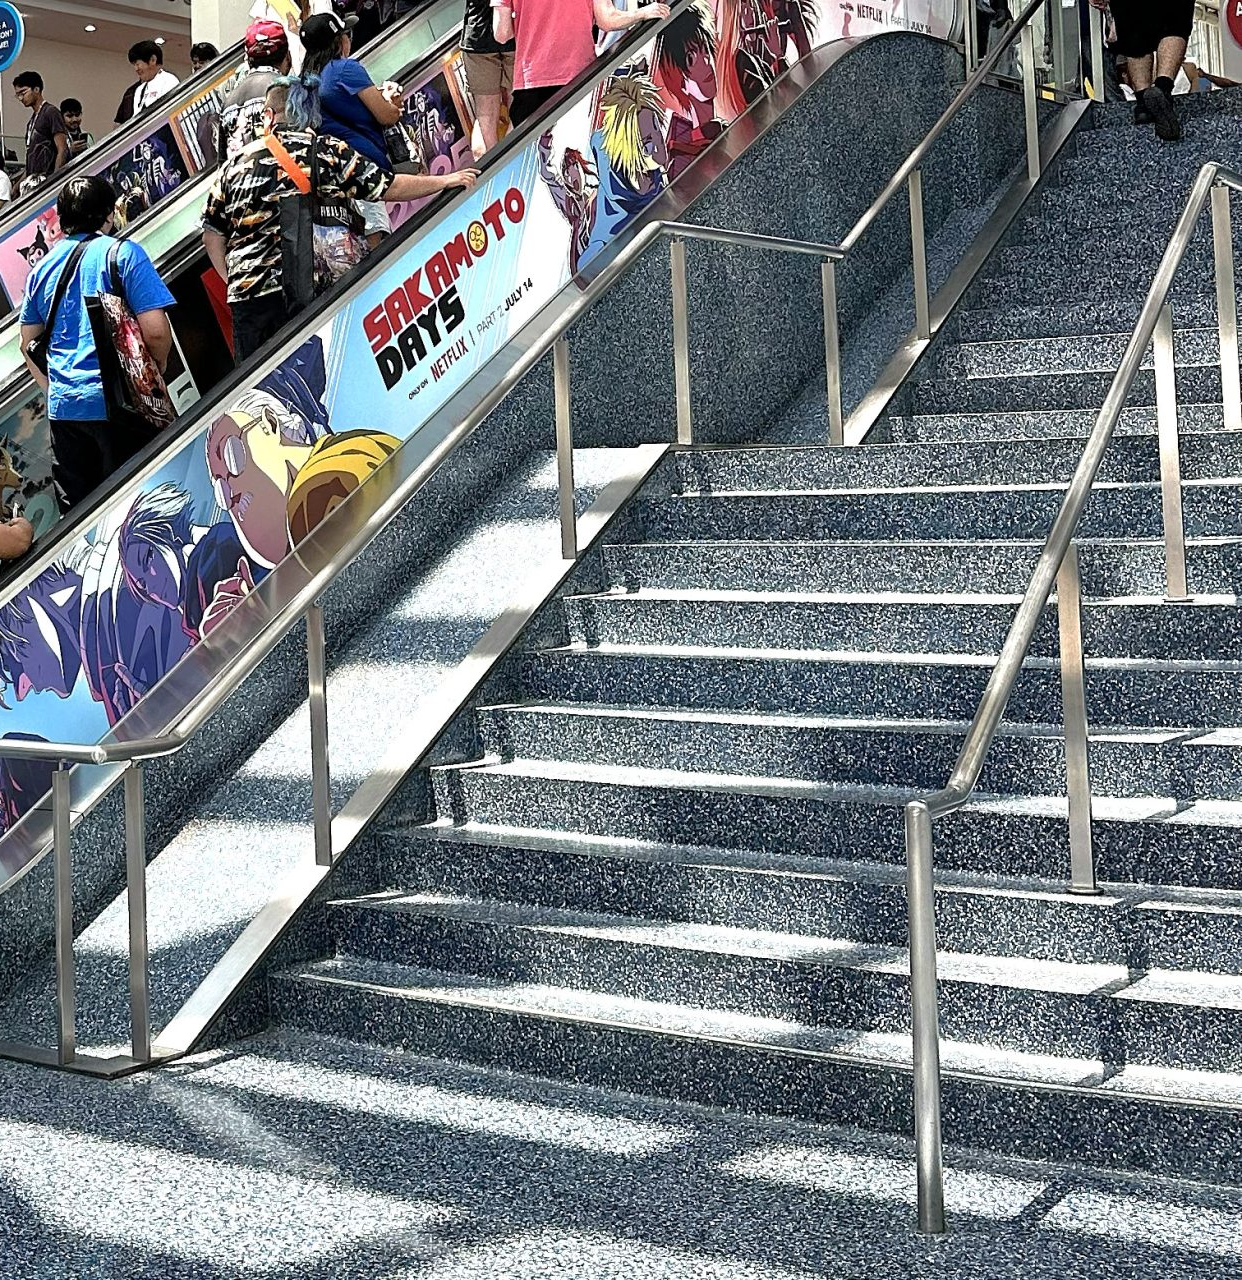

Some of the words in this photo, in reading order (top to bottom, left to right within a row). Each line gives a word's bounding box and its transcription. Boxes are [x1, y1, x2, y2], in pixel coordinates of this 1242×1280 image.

[1, 21, 7, 29] A
[857, 3, 883, 24] NETFLIX
[362, 187, 525, 354] SAKAMOTO
[375, 284, 466, 391] DAYS
[408, 384, 422, 400] ONLY
[421, 378, 429, 389] ON
[430, 336, 469, 383] NETFLIX
[477, 314, 498, 336] PART
[497, 305, 505, 318] 2
[504, 288, 523, 312] JULY
[523, 277, 533, 294] 14
